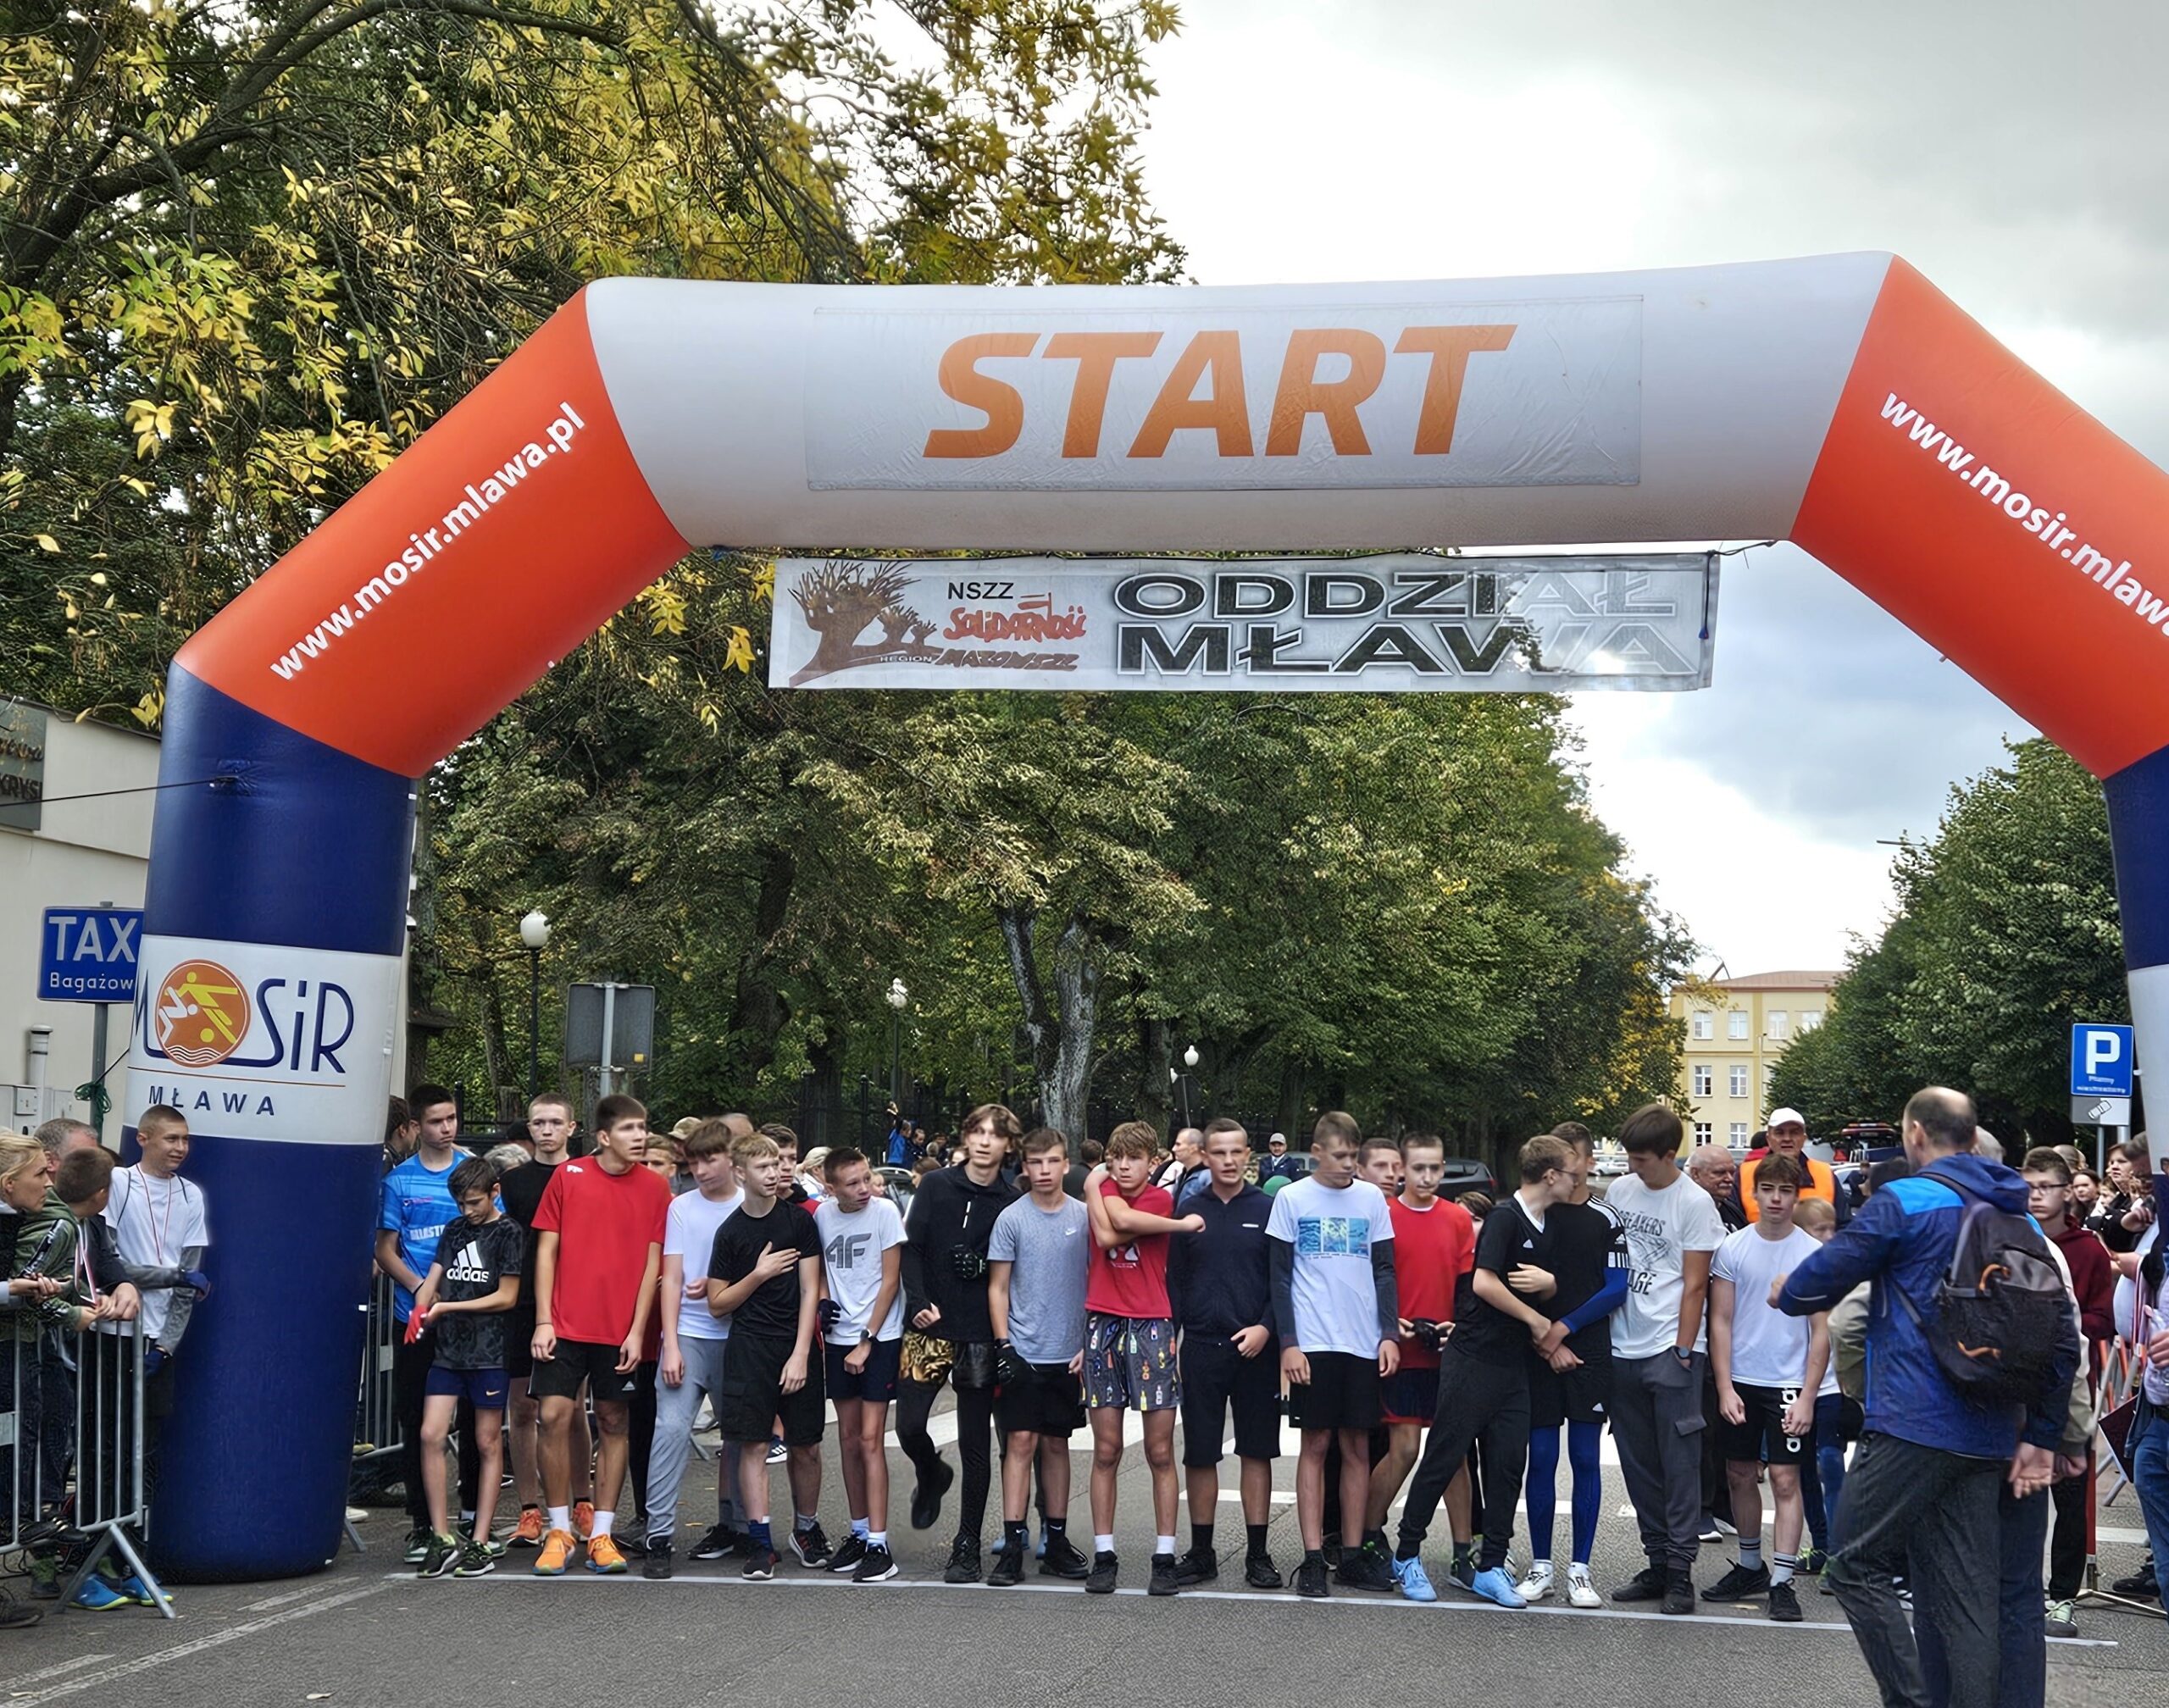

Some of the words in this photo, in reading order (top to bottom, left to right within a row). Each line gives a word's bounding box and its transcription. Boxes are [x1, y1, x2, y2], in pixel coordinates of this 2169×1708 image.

[923, 324, 1519, 458] START
[269, 401, 586, 681] www.mosir.mlawa.pl
[947, 581, 1015, 600] NSZZ
[1114, 571, 1677, 619] ODDZIAŁ
[879, 655, 933, 663] REGION
[1116, 620, 1699, 678] MŁAWA
[48, 916, 137, 963] TAX
[50, 971, 134, 994] Bagażow
[2086, 1030, 2121, 1075] P
[149, 1085, 275, 1117] MŁAWA
[825, 1233, 872, 1268] 4F
[447, 1266, 490, 1283] adidas
